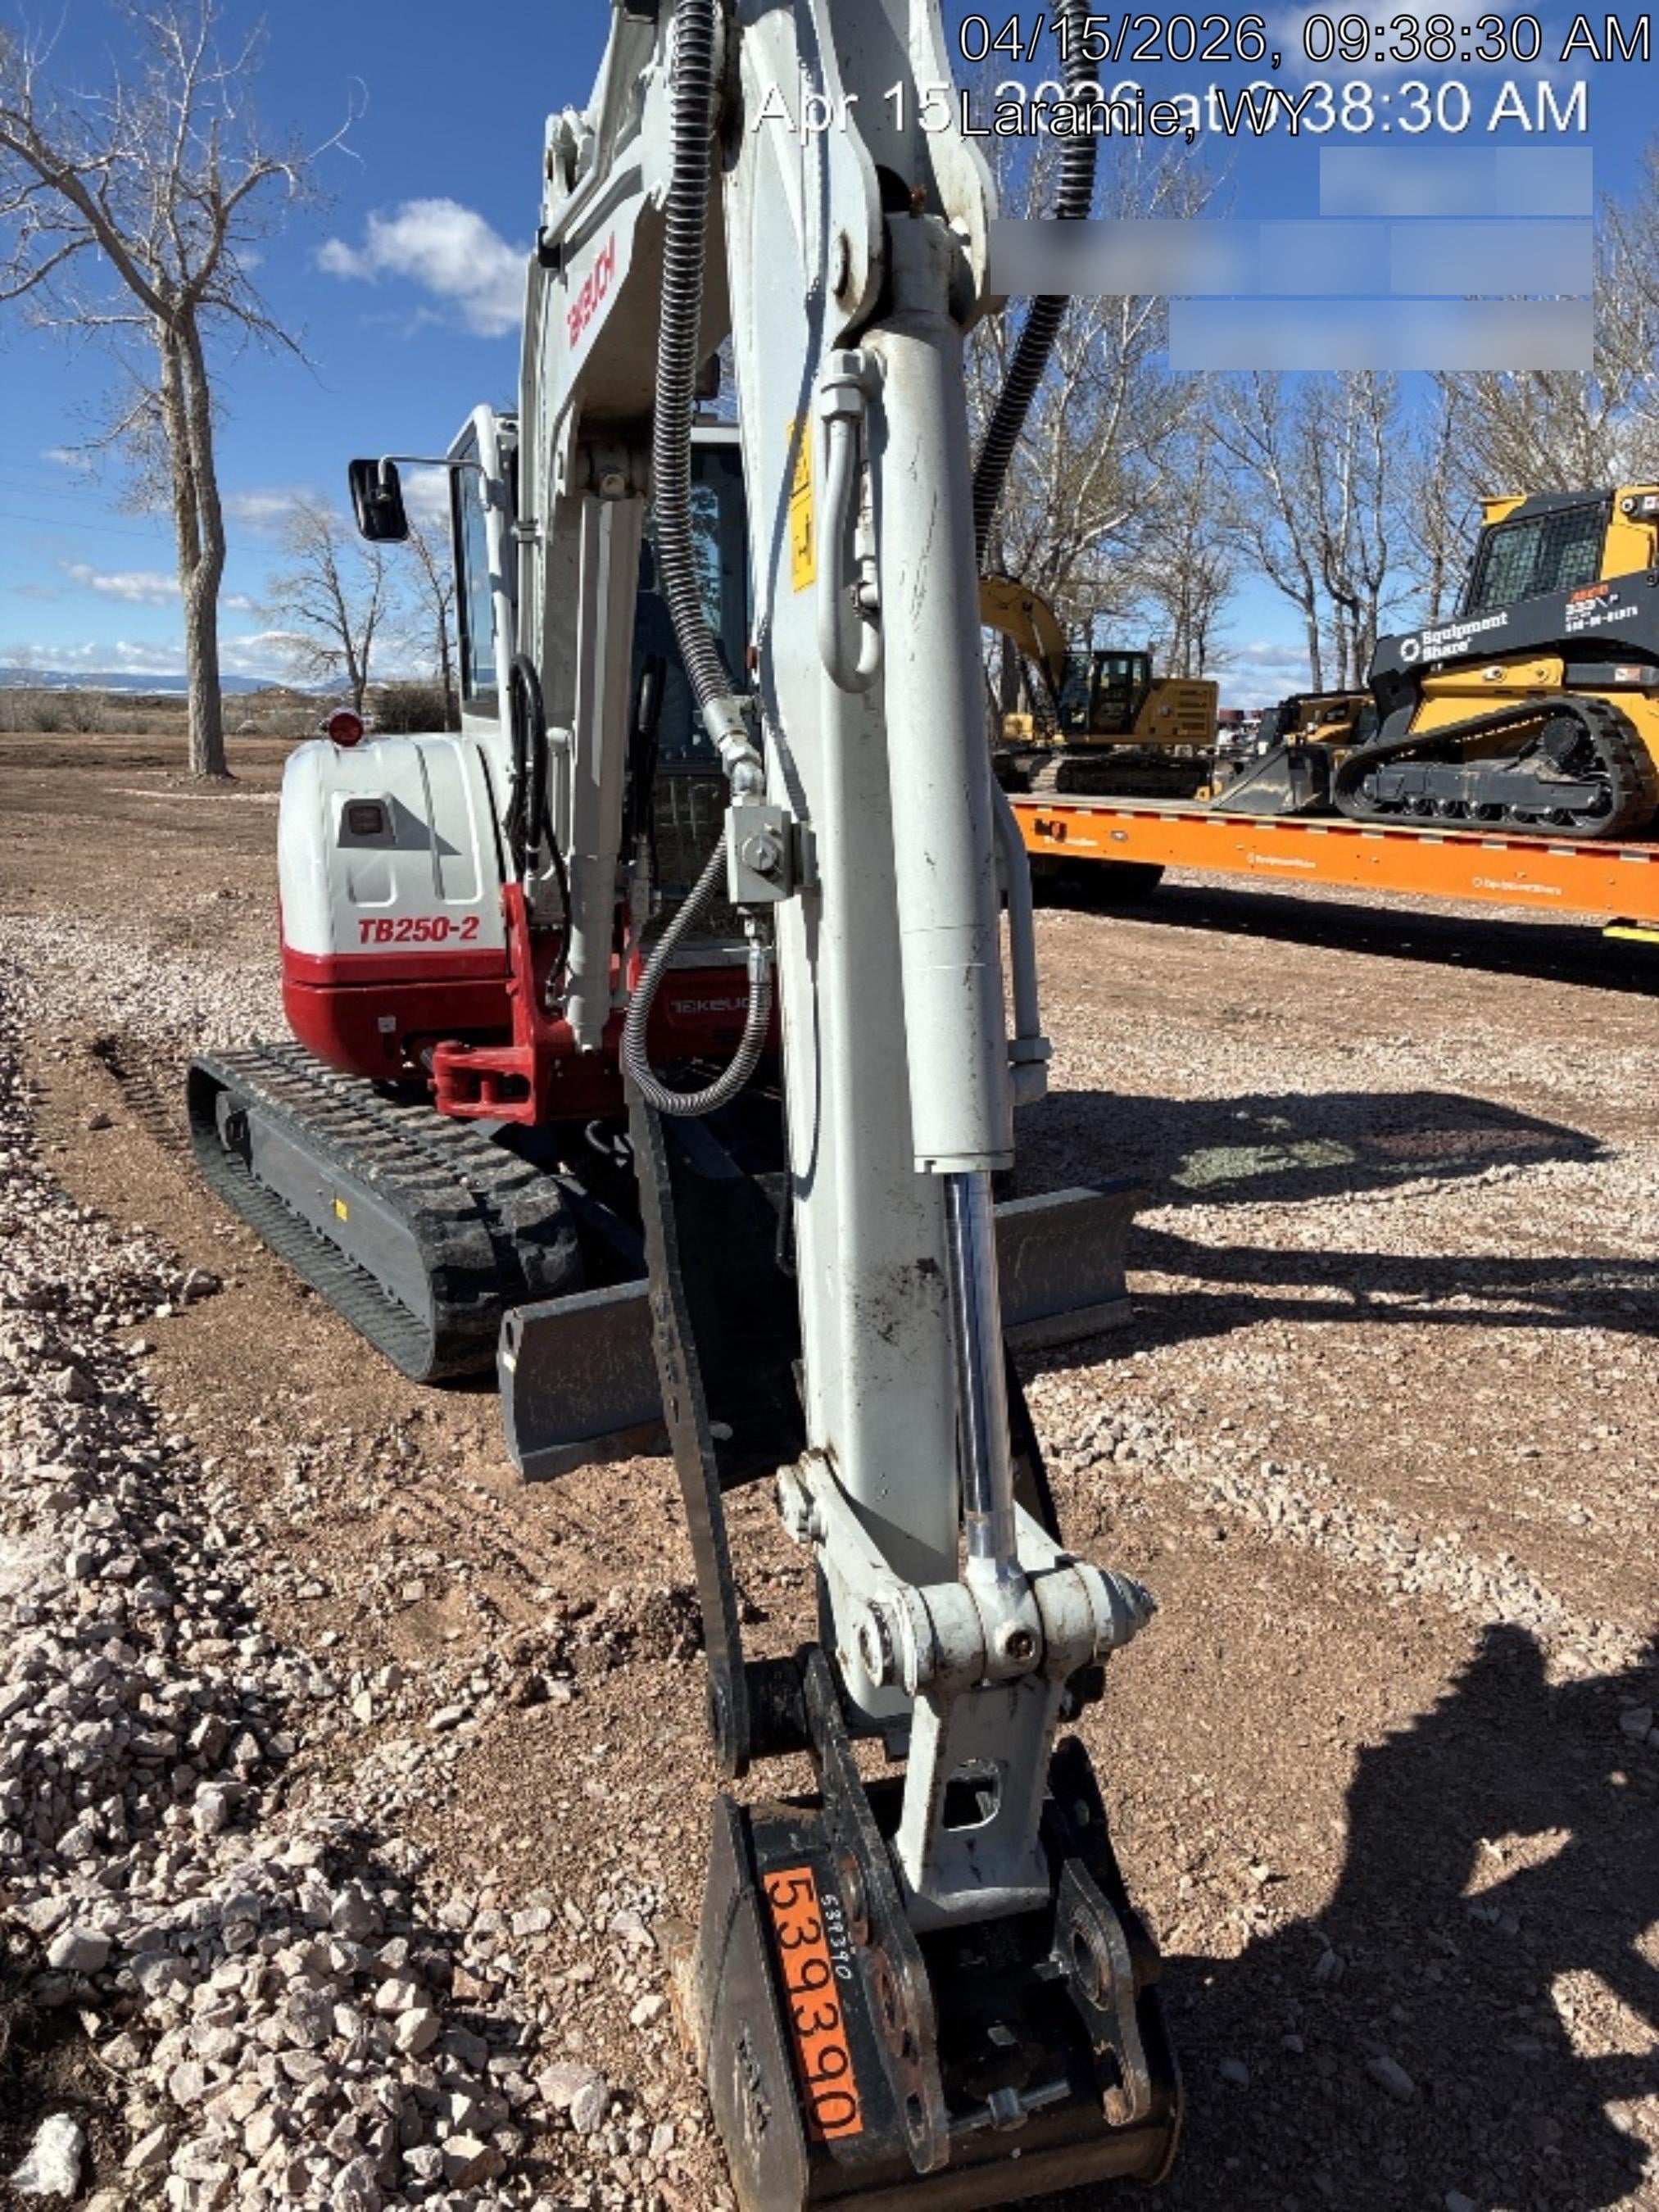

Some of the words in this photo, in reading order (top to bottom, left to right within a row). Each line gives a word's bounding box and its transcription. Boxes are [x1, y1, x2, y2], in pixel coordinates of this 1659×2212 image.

[1422, 611, 1508, 646] Equipment
[358, 916, 480, 945] TB250-2
[671, 997, 750, 1013] TAKEUC
[769, 1879, 856, 2130] 539390
